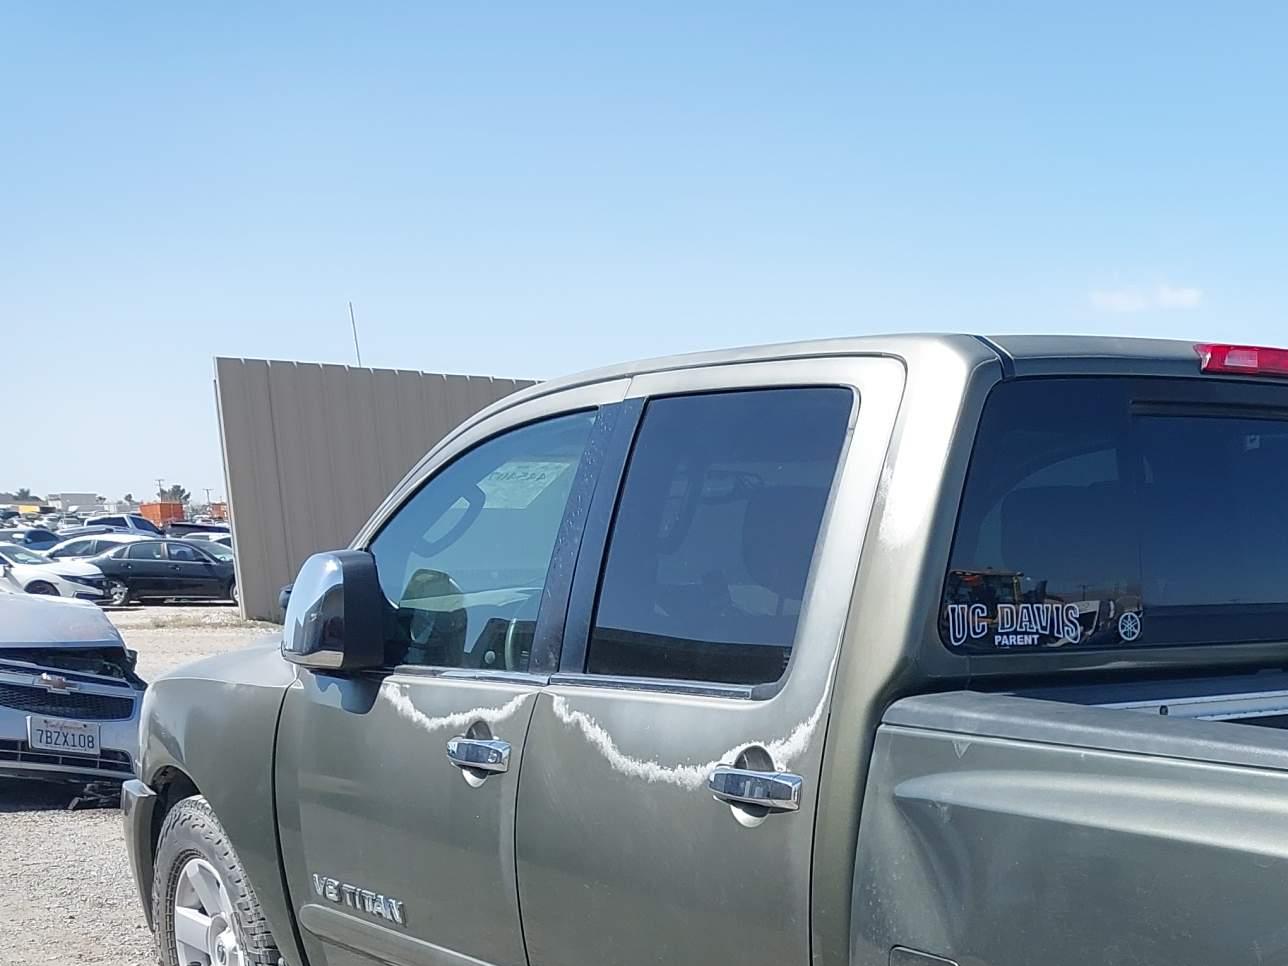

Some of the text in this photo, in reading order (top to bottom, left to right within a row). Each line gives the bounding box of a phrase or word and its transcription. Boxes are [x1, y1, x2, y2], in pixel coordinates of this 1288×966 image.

[948, 604, 1081, 646] UC DAVIS
[994, 634, 1040, 646] PARENT
[36, 728, 95, 749] 7BZX108
[341, 883, 405, 925] TITAN
